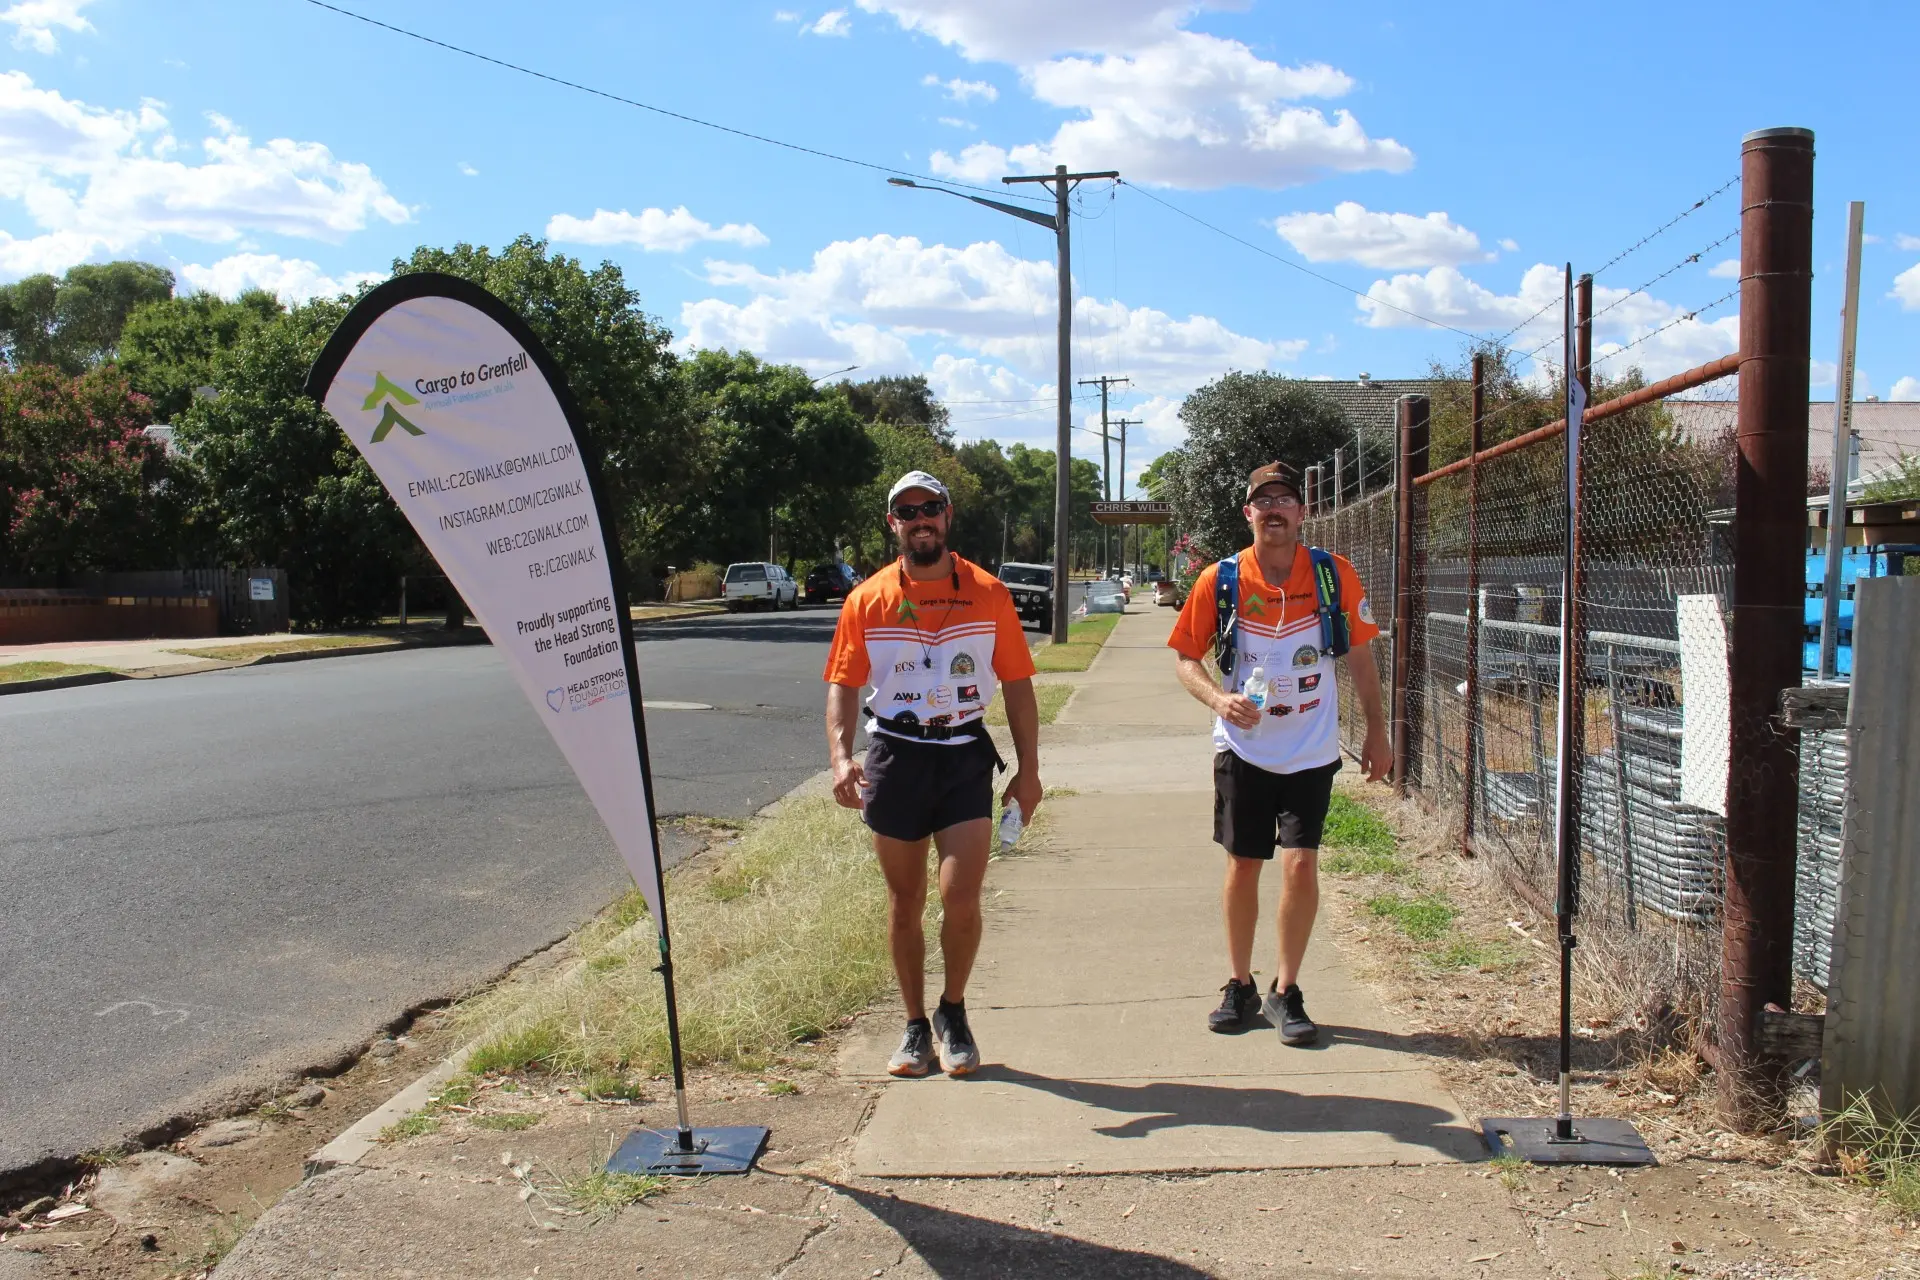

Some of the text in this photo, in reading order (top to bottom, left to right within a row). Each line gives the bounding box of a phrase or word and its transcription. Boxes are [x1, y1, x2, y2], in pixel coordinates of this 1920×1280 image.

[415, 352, 528, 394] Cargo to Grenfell
[493, 380, 515, 393] Walk
[408, 443, 575, 498] EMAIL:C2GWALK@GMAIL.COM
[439, 479, 584, 531] INSTAGRAM.COM/C2GWALK
[1095, 503, 1171, 511] CHRIS WILLI
[486, 513, 589, 556] WEB:C2GWALK.COM
[528, 546, 597, 580] FB:/C2GWALK
[517, 596, 611, 635] Proudly supporting
[535, 618, 615, 653] the Head Strong
[564, 640, 618, 667] Foundation
[895, 661, 915, 673] ECS
[567, 669, 624, 694] HEAD STRONG
[569, 679, 627, 705] FOUNDATION
